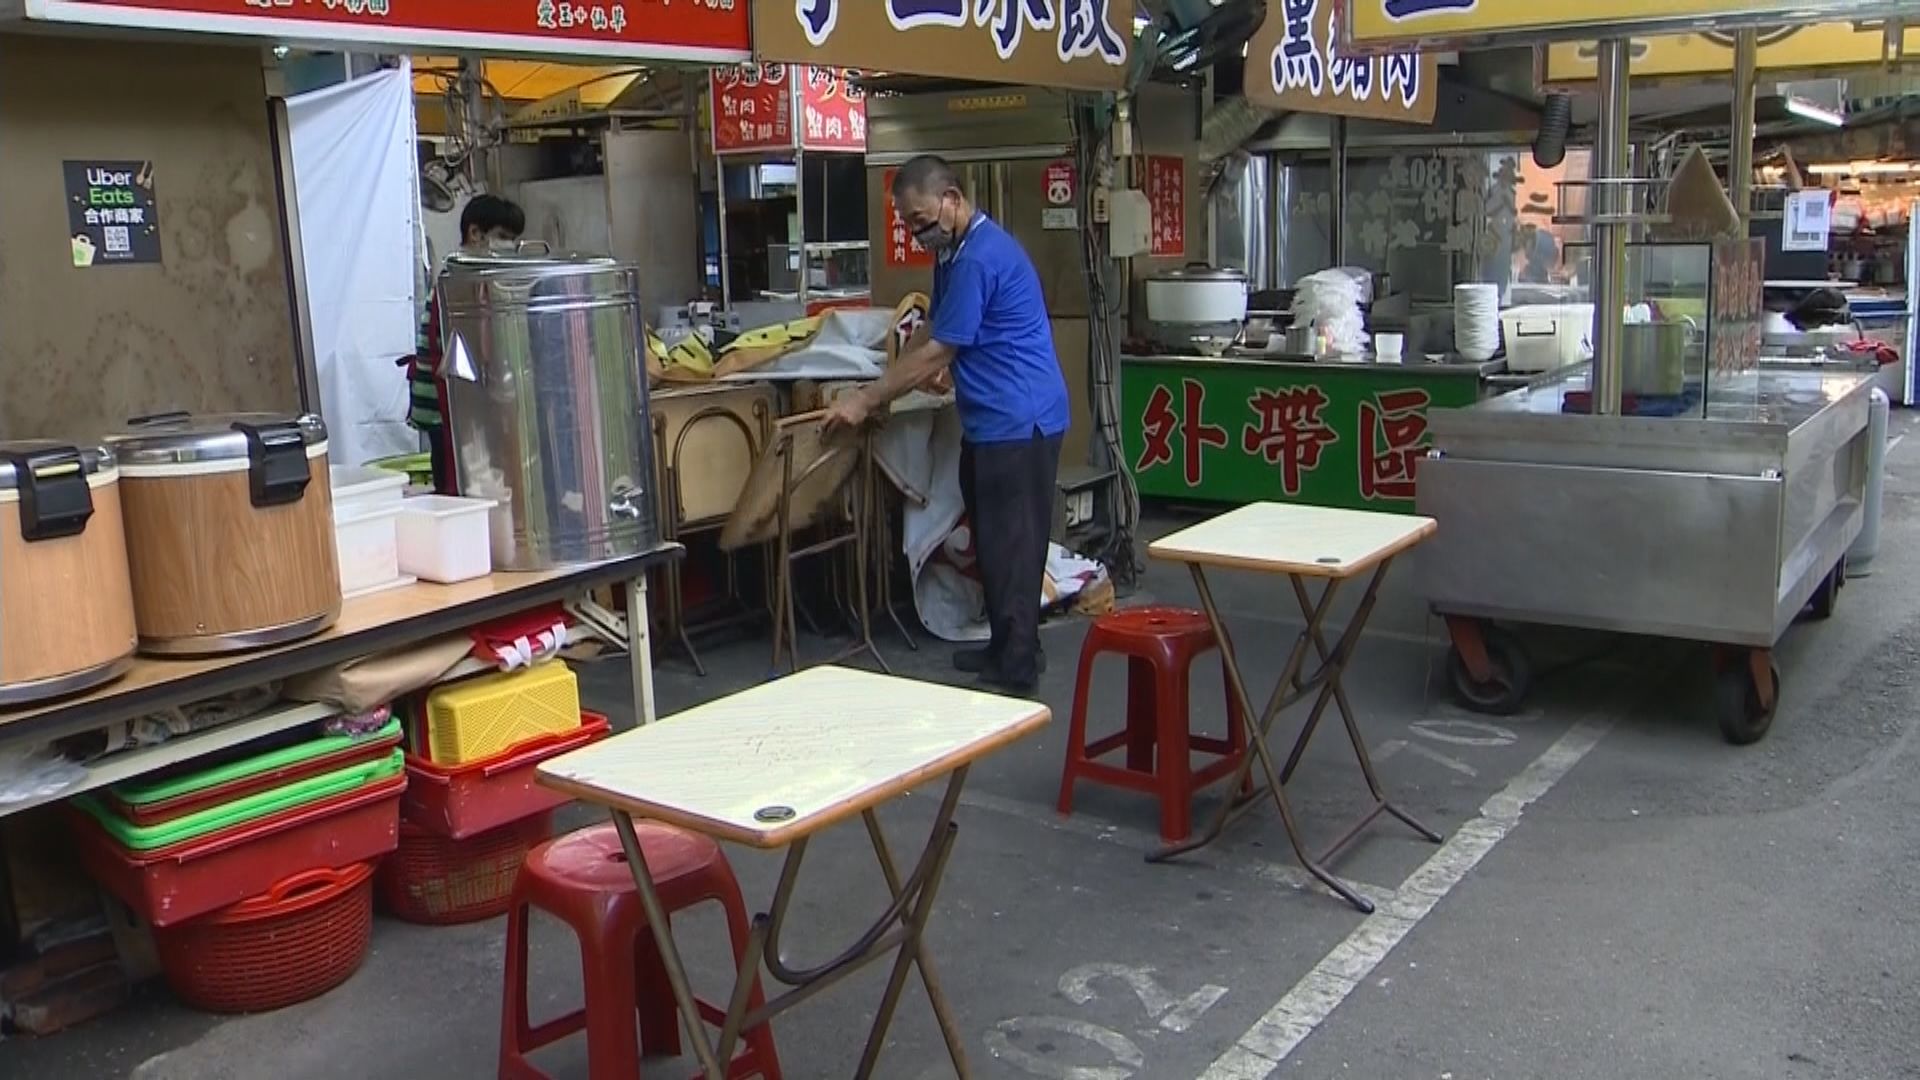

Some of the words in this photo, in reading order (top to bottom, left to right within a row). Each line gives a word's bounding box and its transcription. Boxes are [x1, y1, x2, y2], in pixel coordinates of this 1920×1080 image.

[537, 0, 627, 33] 愛玉+仙草
[86, 167, 132, 186] Uber
[88, 187, 134, 204] Eats
[84, 207, 144, 224] 合作商家
[1136, 377, 1431, 500] 外帶區
